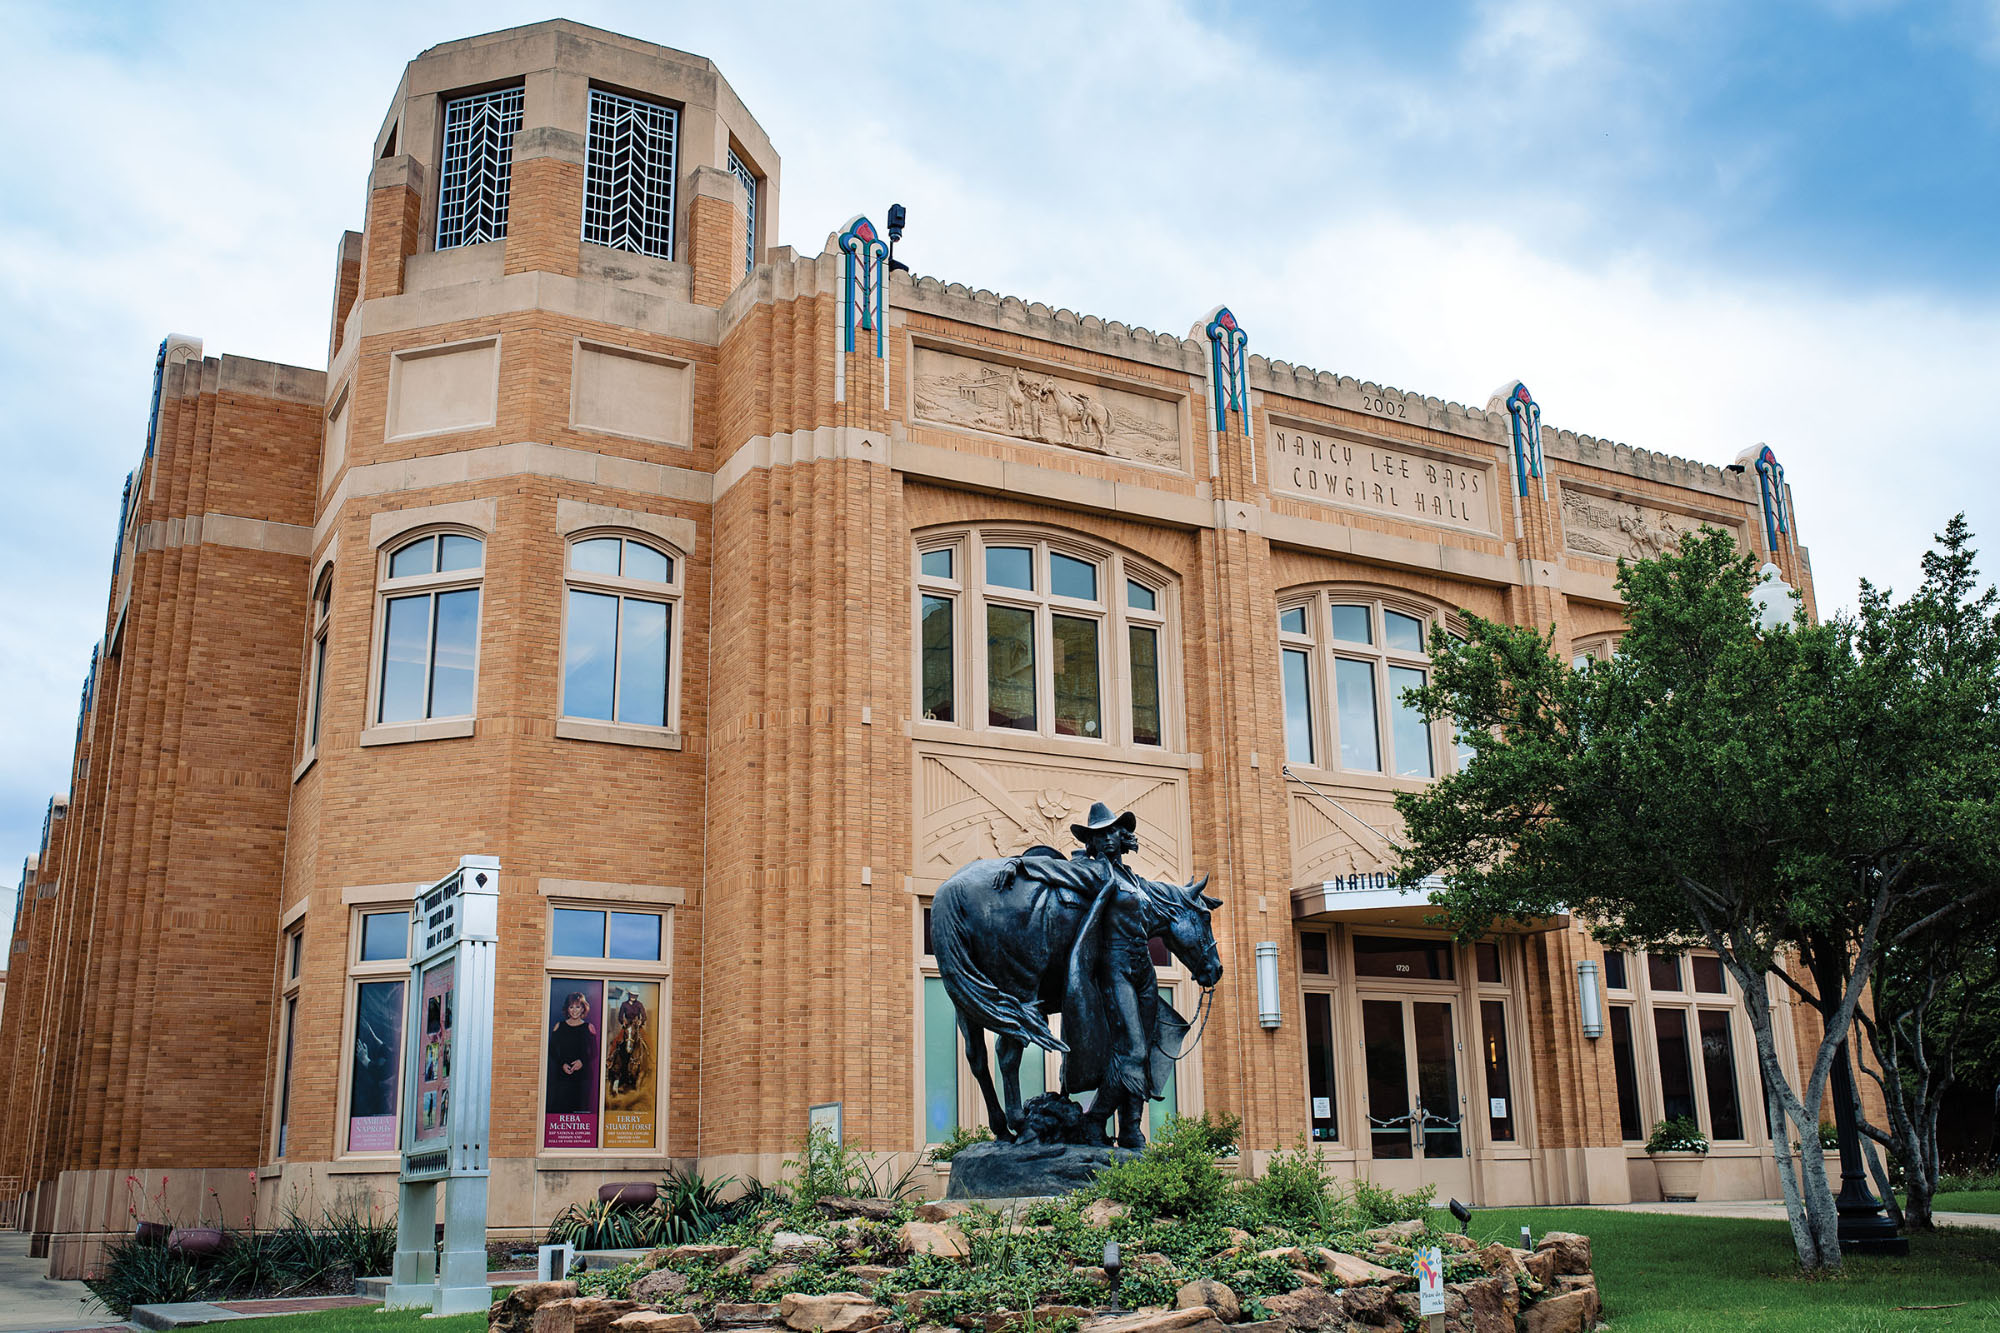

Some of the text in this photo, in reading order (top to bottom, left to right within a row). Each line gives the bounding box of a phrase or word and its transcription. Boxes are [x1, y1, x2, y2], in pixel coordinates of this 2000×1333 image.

[1363, 396, 1406, 419] 2002
[1276, 431, 1479, 493] NANCY LEE BASS
[1293, 467, 1470, 521] COWGIRL HALL
[1335, 871, 1396, 891] NATION
[1395, 964, 1410, 972] 1720
[559, 1114, 581, 1123] REBA
[616, 1115, 641, 1123] TERRY
[549, 1122, 591, 1130] McENTIRE
[605, 1123, 630, 1131] STUART
